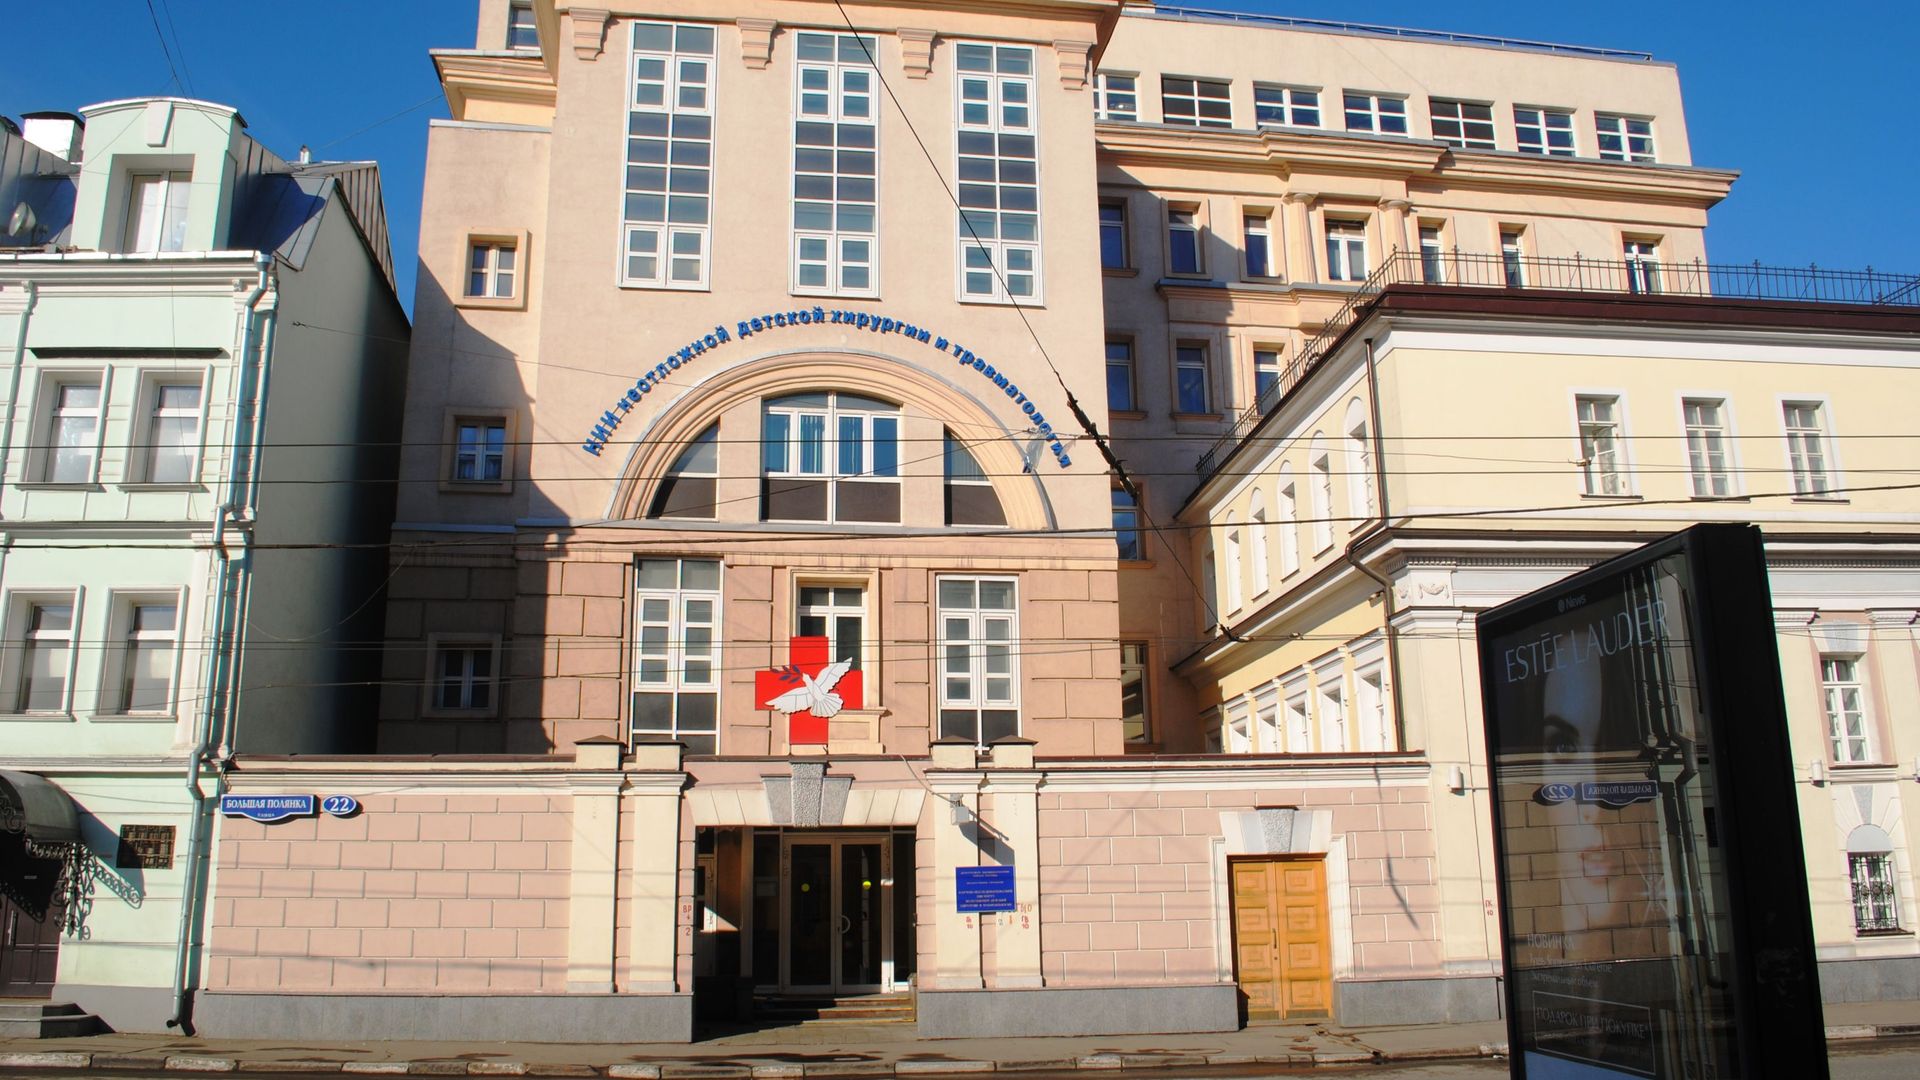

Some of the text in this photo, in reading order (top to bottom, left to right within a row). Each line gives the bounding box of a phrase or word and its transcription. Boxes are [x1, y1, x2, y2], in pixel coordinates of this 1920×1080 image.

[582, 306, 1072, 470] НИИ неотложной детской хирургии и травматологии
[1571, 600, 1671, 664] LAUDER
[226, 798, 307, 809] БОЛЬШАЯ ПОЛЯНКА
[330, 798, 349, 812] 22
